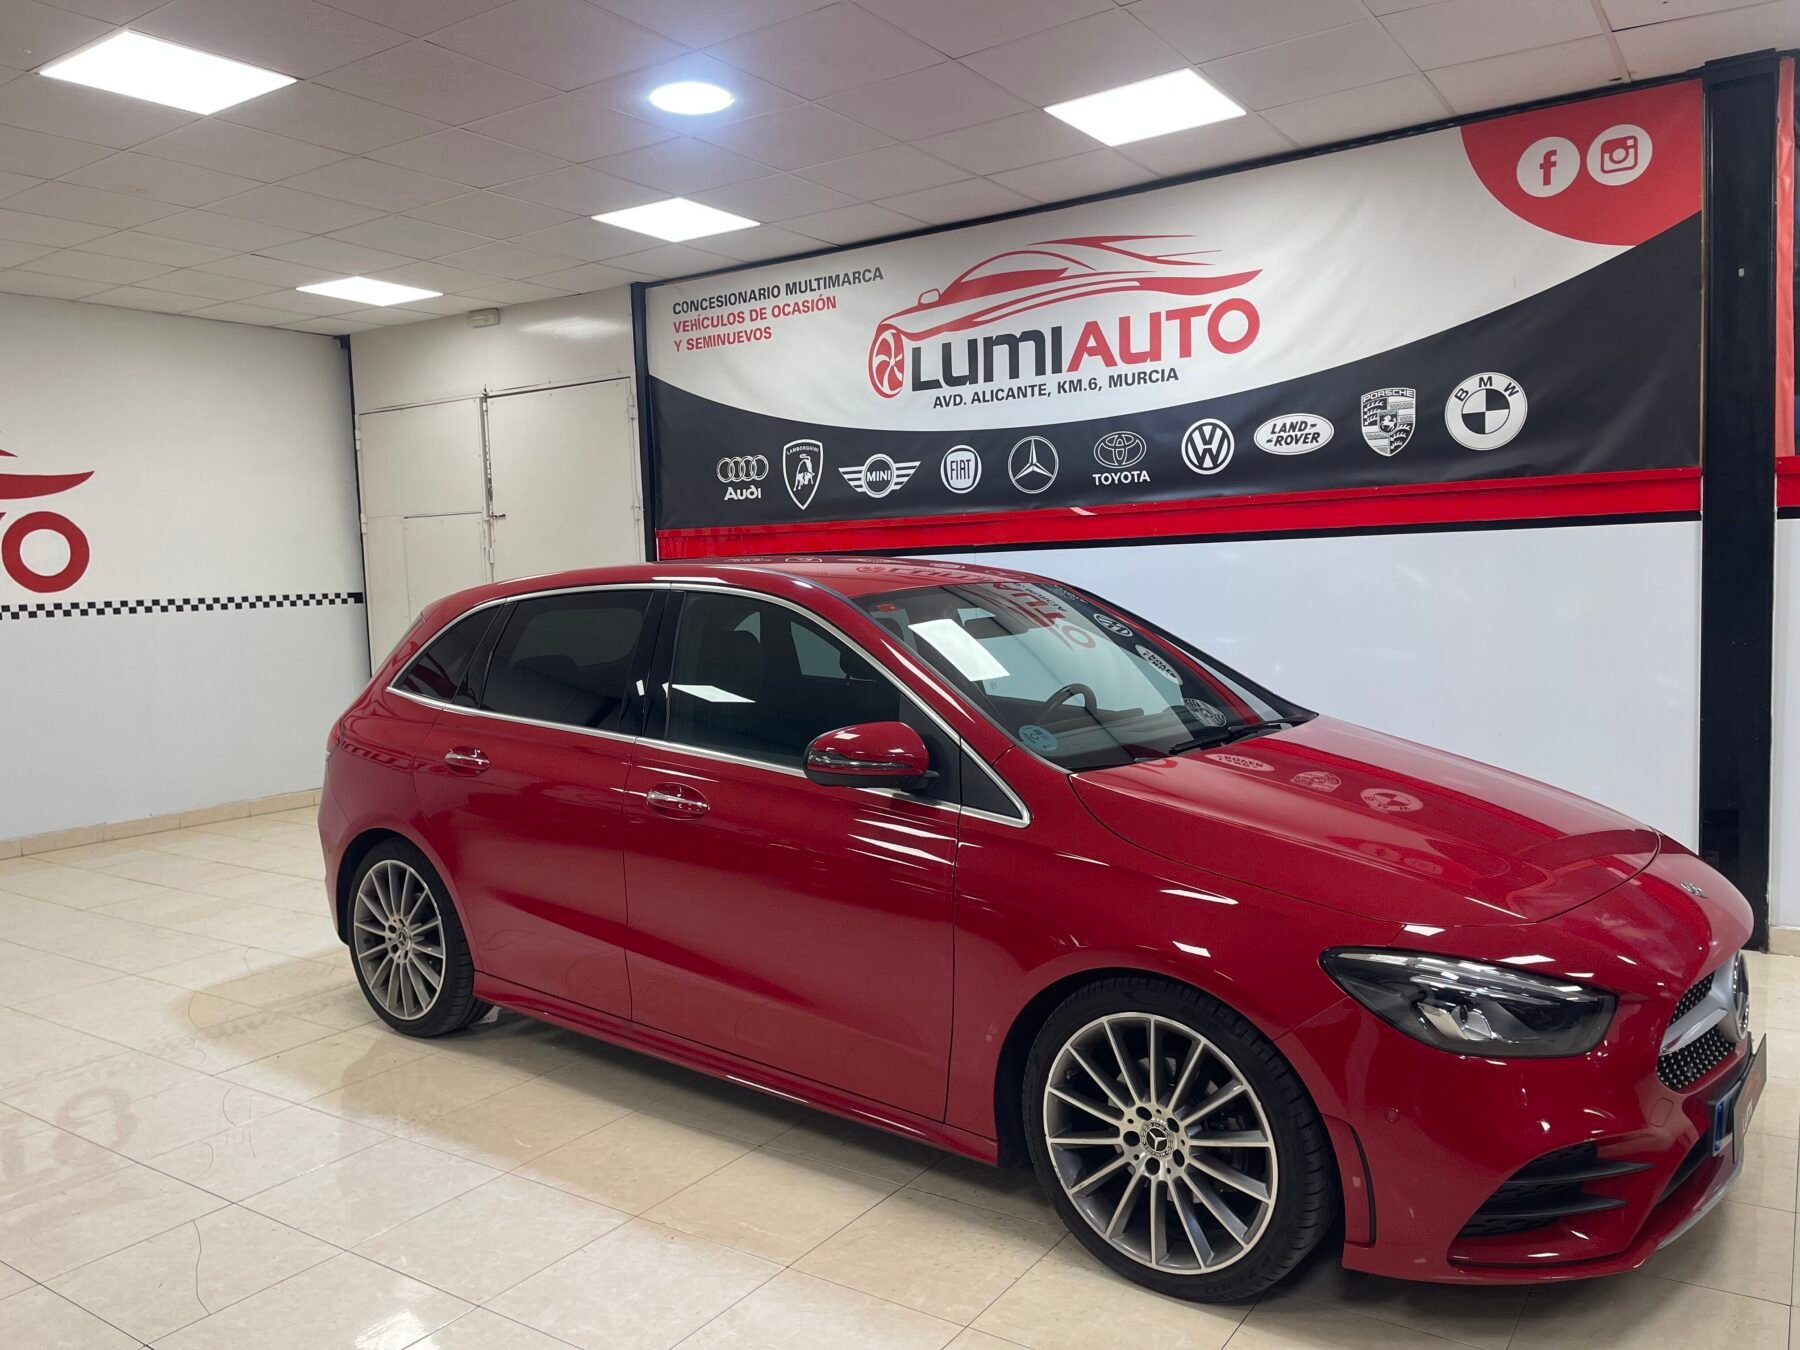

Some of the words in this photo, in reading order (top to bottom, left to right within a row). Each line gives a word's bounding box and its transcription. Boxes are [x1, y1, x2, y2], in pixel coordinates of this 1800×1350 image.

[673, 284, 781, 315] CONCESIONARIO
[785, 266, 884, 296] MULTIMARCA
[673, 311, 746, 334] VEHÍCULOS
[748, 306, 768, 322] DE
[771, 294, 837, 319] OCASIÓN
[673, 339, 683, 353] Y
[686, 326, 772, 351] SEMINUEVOS
[932, 395, 967, 409] AVD.
[970, 384, 1052, 405] ALICANTE,
[1107, 367, 1180, 389] MURCIA
[1363, 389, 1414, 402] PORSCHE
[786, 445, 820, 455] LAMBORGHINI
[866, 470, 892, 482] MINI
[949, 459, 972, 482] FIAT
[1092, 470, 1151, 487] TOYOTA
